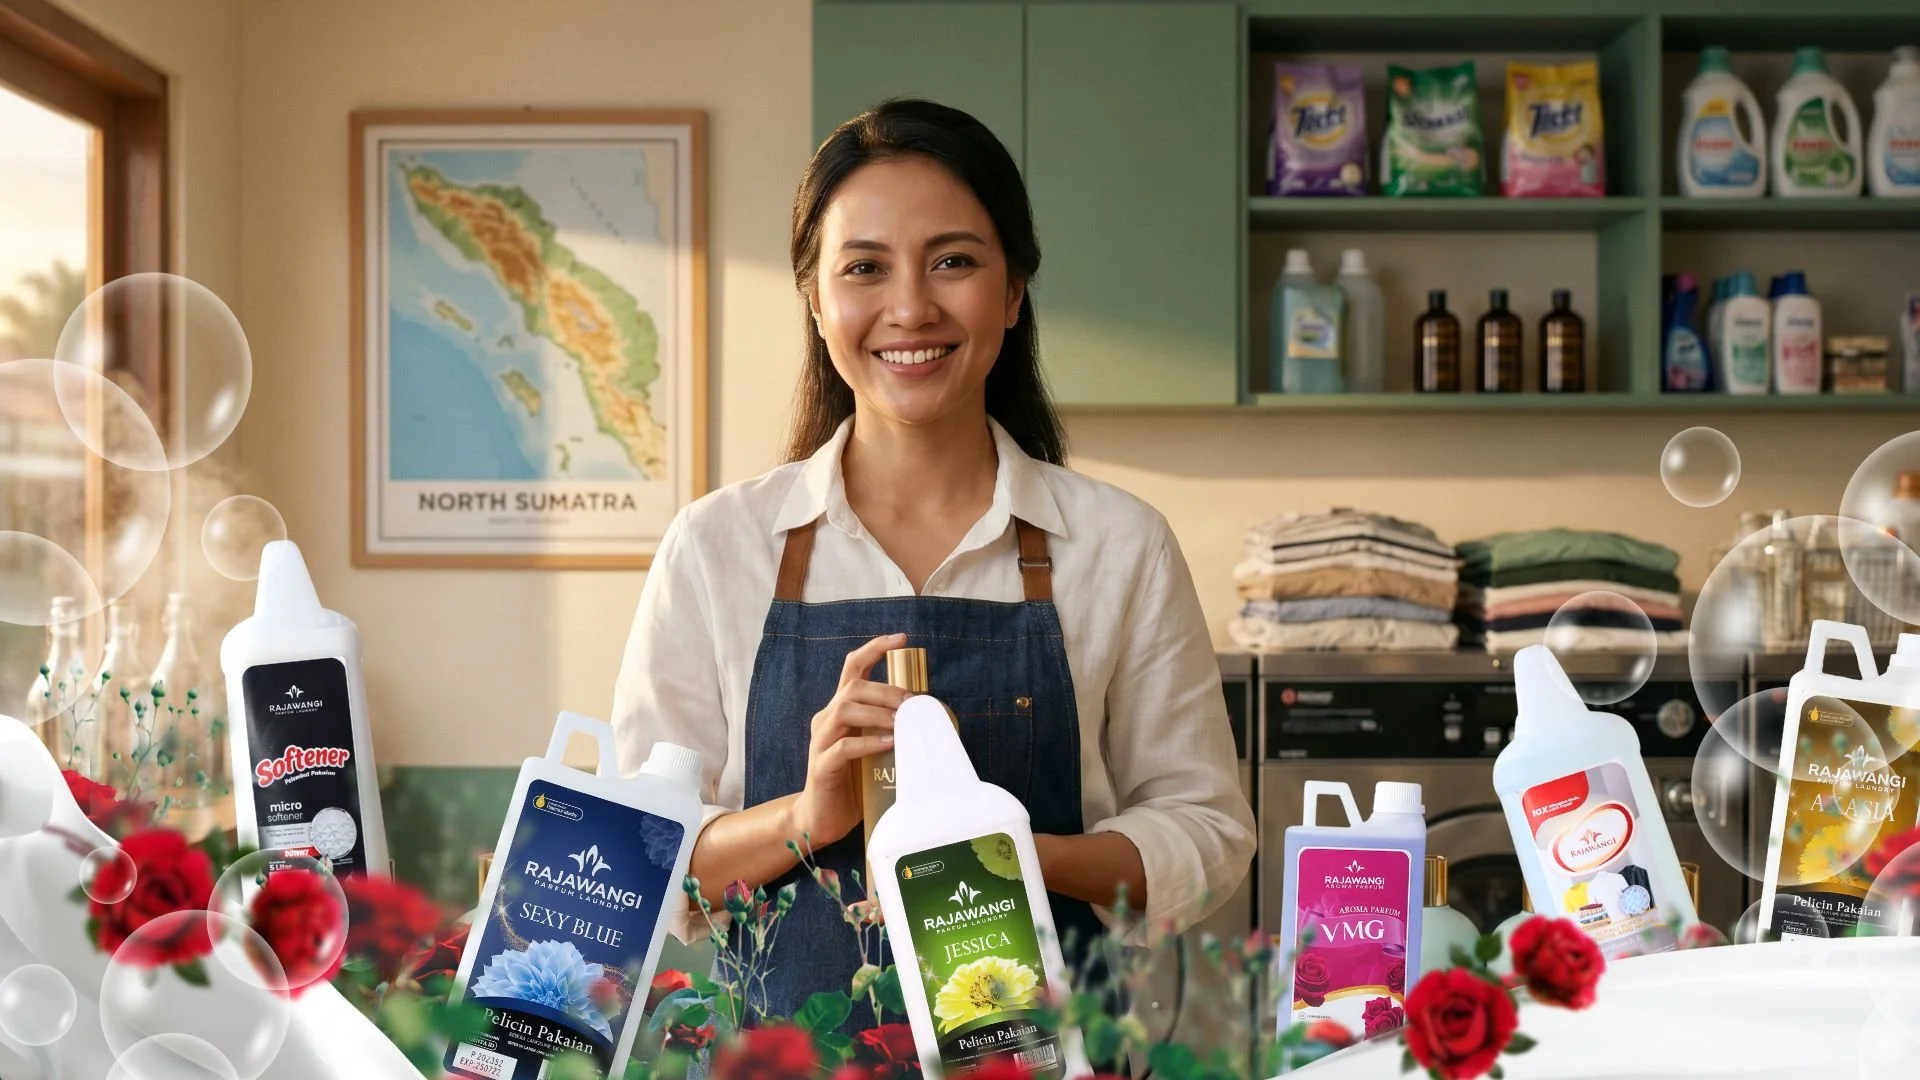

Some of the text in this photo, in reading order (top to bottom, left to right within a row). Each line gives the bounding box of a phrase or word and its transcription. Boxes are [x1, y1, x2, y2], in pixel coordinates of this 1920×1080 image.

[418, 492, 638, 511] NORTH SUMATRA
[269, 700, 323, 712] RAJAWANGI
[255, 744, 350, 788] Softener
[1808, 763, 1907, 788] RAJAWANGI
[1855, 784, 1895, 794] LAUNDRY
[267, 812, 303, 822] softener
[270, 801, 303, 812] micro
[1532, 805, 1549, 818] 10X
[1810, 793, 1896, 822] AASIA
[1570, 837, 1617, 857] RAJAWANGI
[524, 860, 643, 910] RAJAWANGI
[1324, 875, 1385, 885] RAJAWANGI
[534, 879, 626, 912] PARFUM LAUNDRY
[1793, 895, 1833, 911] Pelicin
[1836, 901, 1881, 917] Pakaian
[923, 898, 1016, 931] RAJAWANGI
[1339, 905, 1368, 914] AROMA
[519, 902, 623, 948] SEXY BLUE
[936, 913, 1009, 935] PARFUM LAUNDRY
[1320, 919, 1386, 944] VMG
[943, 931, 1011, 964] JESSICA
[483, 1007, 533, 1036] Pelicin
[537, 1025, 594, 1054] Pakaian
[958, 1034, 995, 1050] Pelicin
[996, 1024, 1038, 1041] Pakaian
